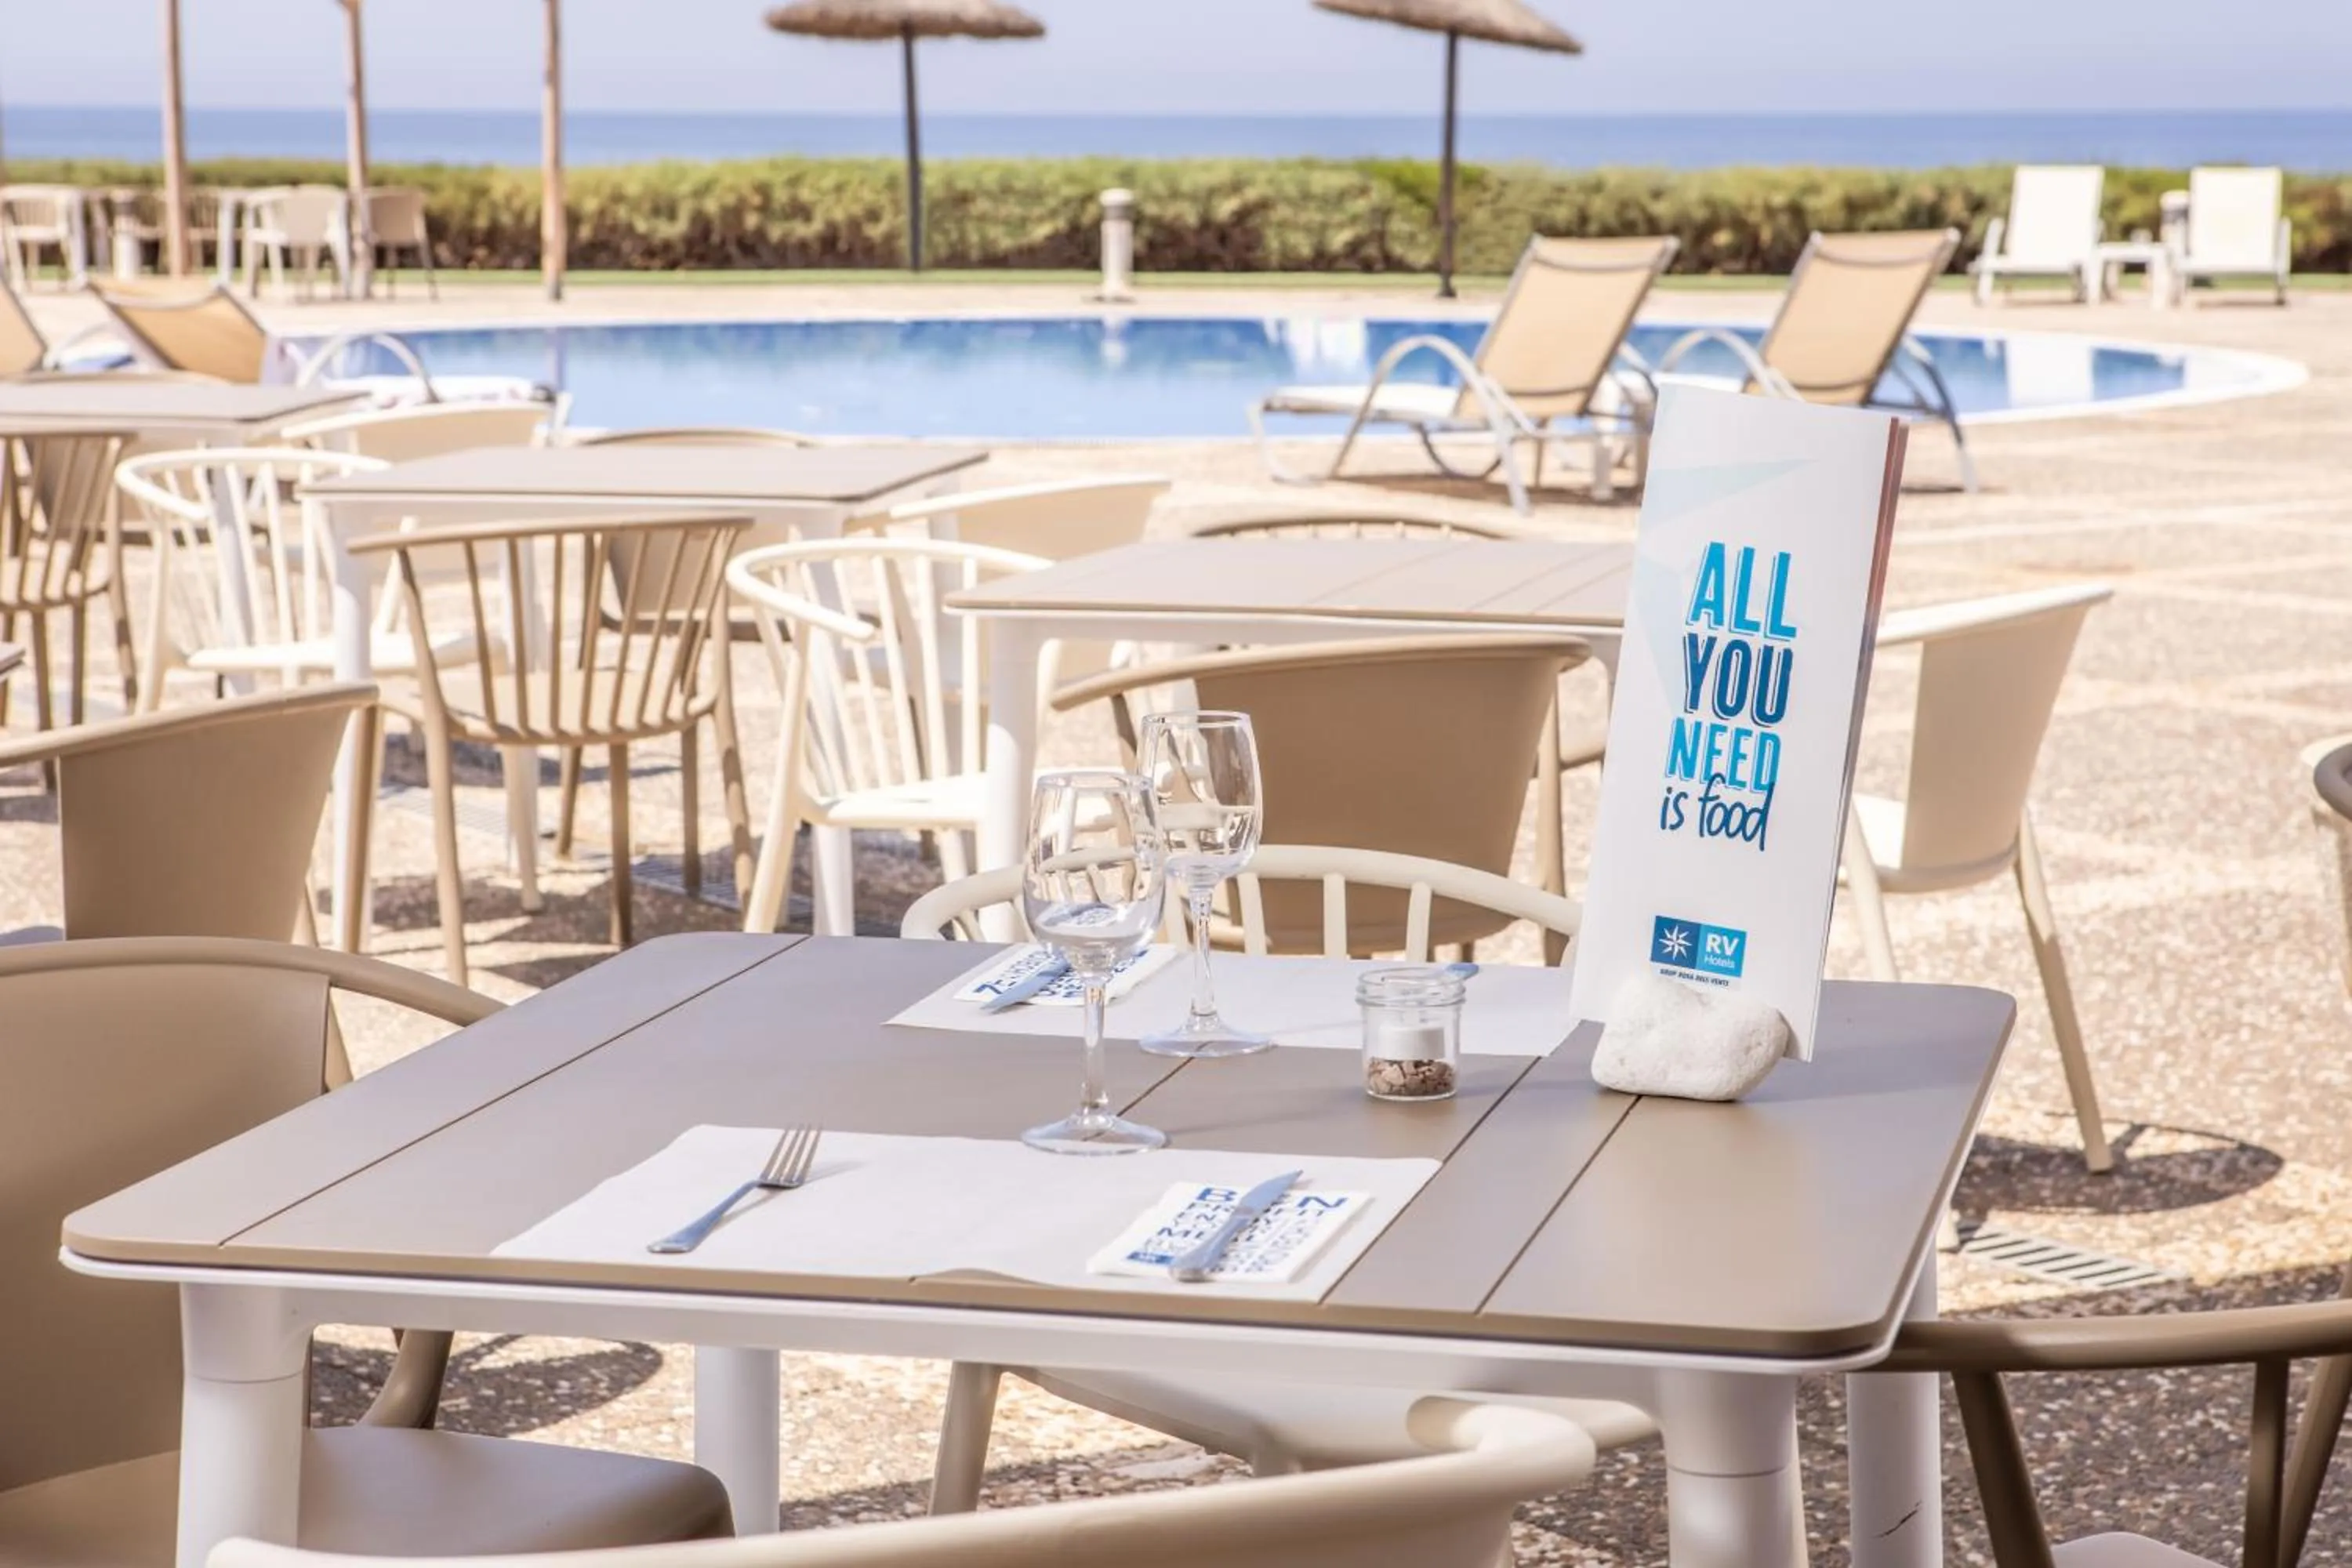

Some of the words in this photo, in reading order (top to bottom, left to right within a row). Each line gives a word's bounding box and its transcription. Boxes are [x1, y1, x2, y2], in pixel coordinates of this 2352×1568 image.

[1686, 542, 1797, 641] ALL
[1682, 632, 1794, 728] YOU
[1665, 717, 1782, 794] NEED
[1661, 786, 1687, 831] is
[1698, 772, 1774, 851] food
[1704, 954, 1735, 968] Hotels
[1705, 933, 1739, 956] RV
